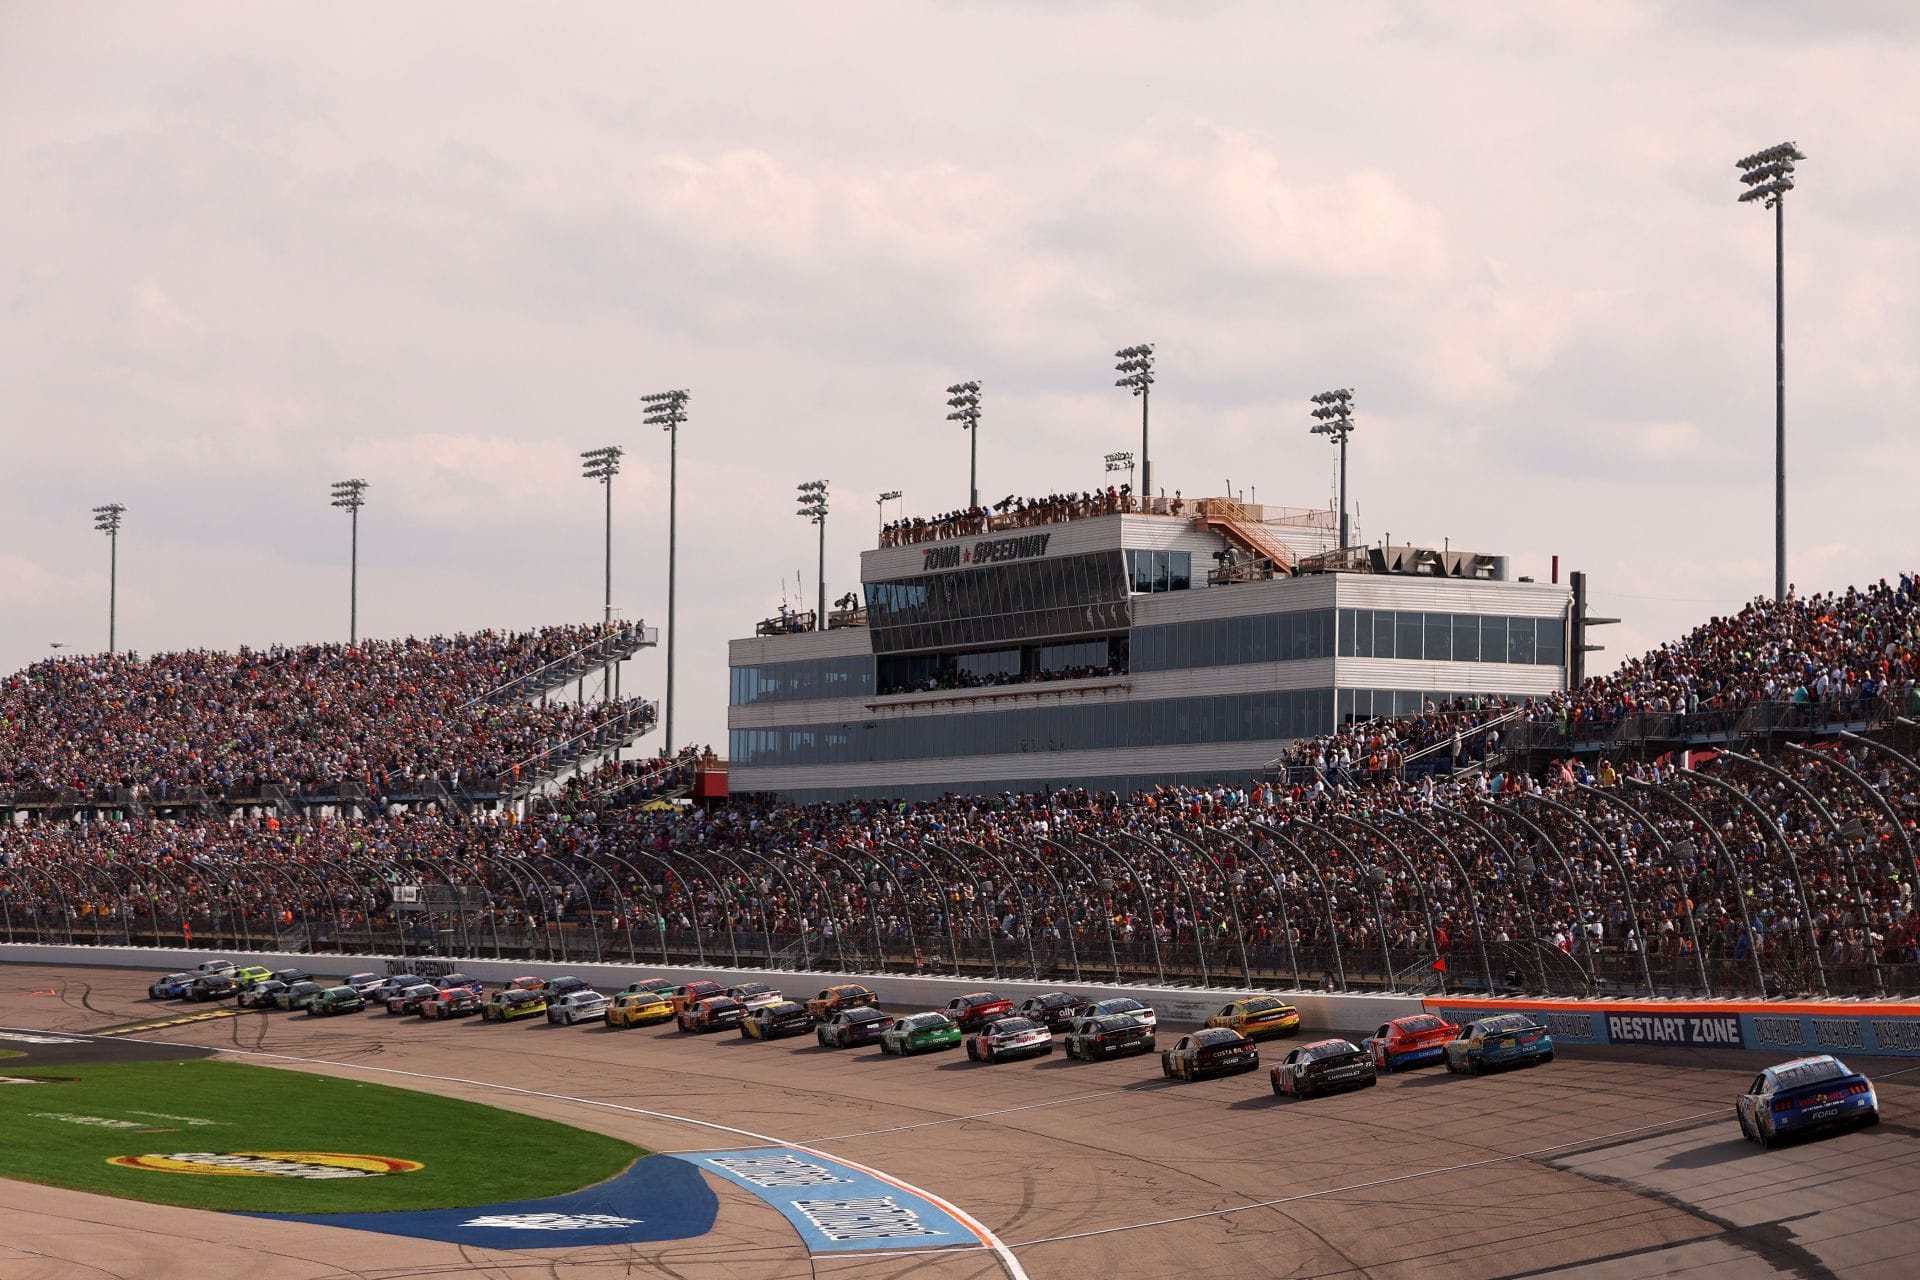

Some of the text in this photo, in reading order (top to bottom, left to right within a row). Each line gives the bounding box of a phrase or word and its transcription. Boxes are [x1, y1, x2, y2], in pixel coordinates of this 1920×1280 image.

[922, 532, 1051, 571] IOWA SPEEDWAY
[385, 960, 455, 977] IOWA SPEEDWAY
[1058, 1007, 1076, 1016] ally
[1609, 1016, 1740, 1043] RESTART ZONE
[1124, 1040, 1141, 1048] TOYOTA
[1212, 1049, 1233, 1058] COSTA
[1327, 1070, 1361, 1081] CHEVROLET
[1812, 1108, 1838, 1121] FORD
